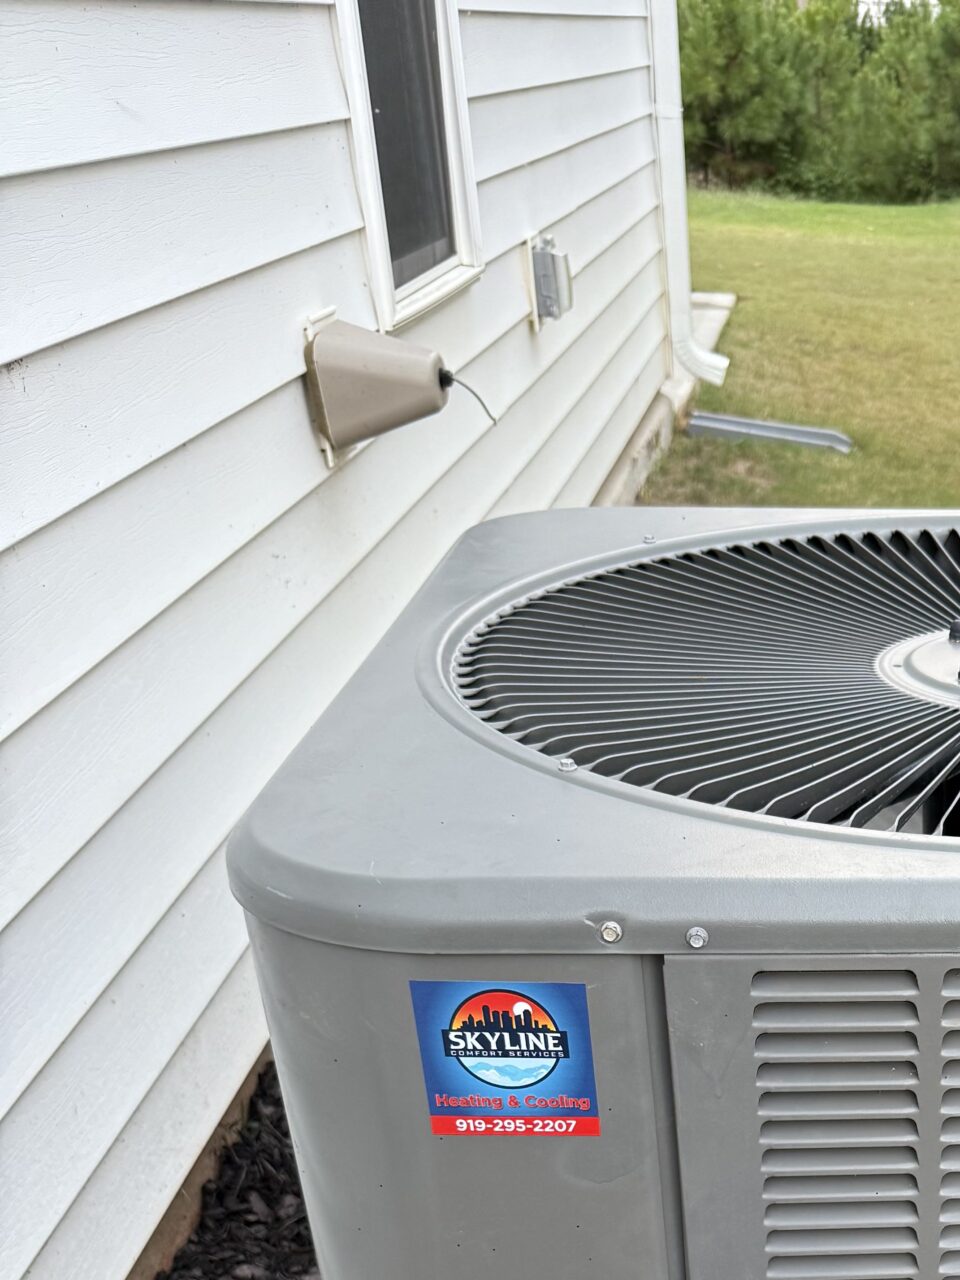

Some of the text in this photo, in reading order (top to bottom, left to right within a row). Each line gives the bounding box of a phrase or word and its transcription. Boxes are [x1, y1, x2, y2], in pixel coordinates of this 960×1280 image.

[448, 1032, 563, 1051] SKYLINE
[435, 1094, 590, 1110] Heating & Cooling
[456, 1119, 576, 1132] 919-295-2207
